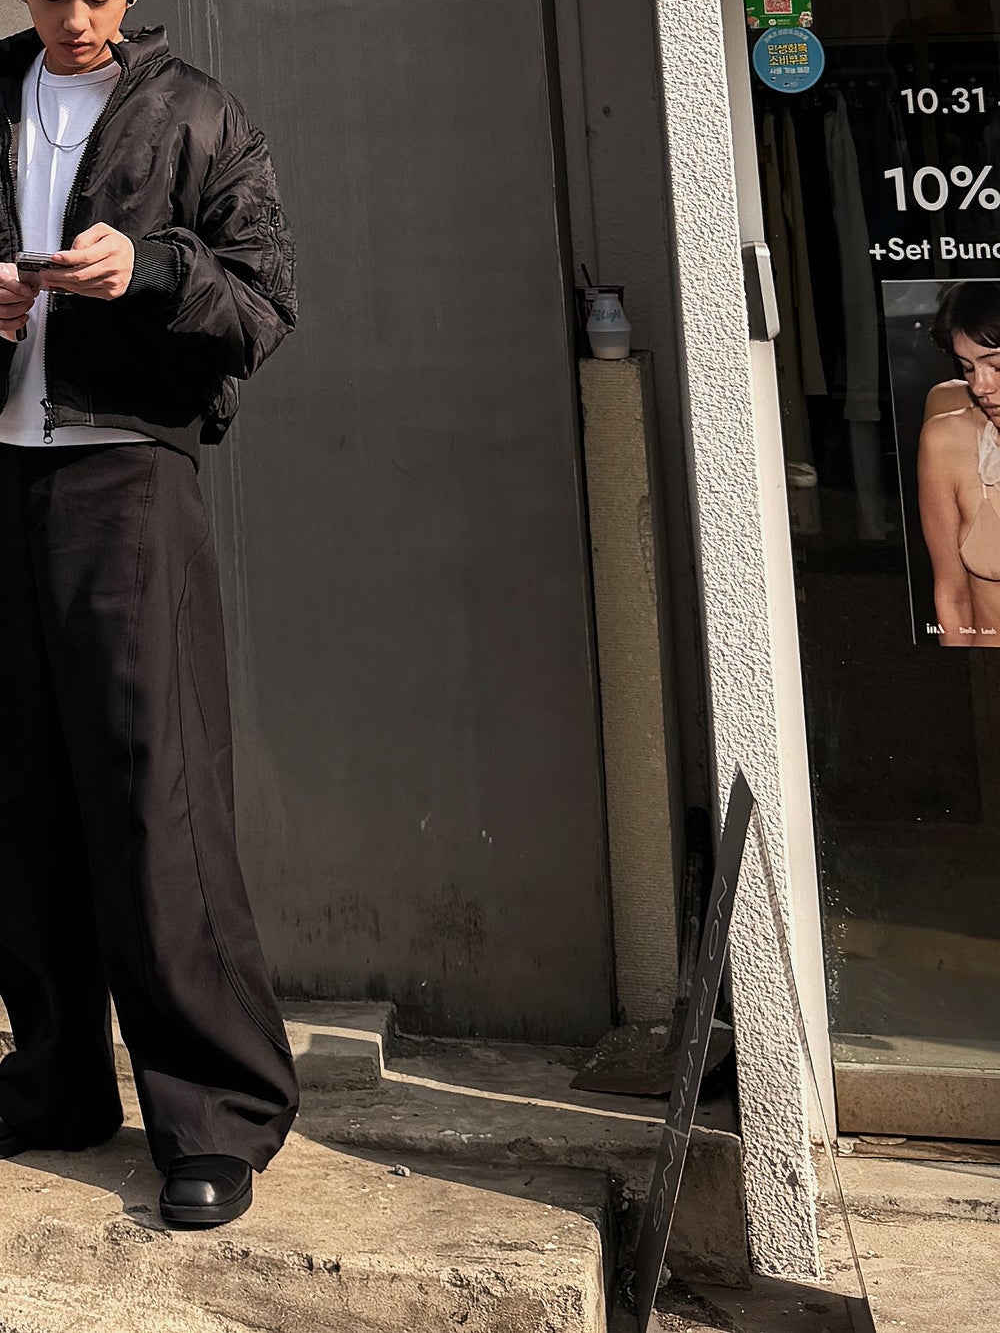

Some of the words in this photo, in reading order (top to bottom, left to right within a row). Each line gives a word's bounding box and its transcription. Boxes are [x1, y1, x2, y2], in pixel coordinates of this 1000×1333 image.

[900, 87, 986, 114] 10.31
[884, 165, 1000, 211] 10%
[869, 237, 931, 261] +Set
